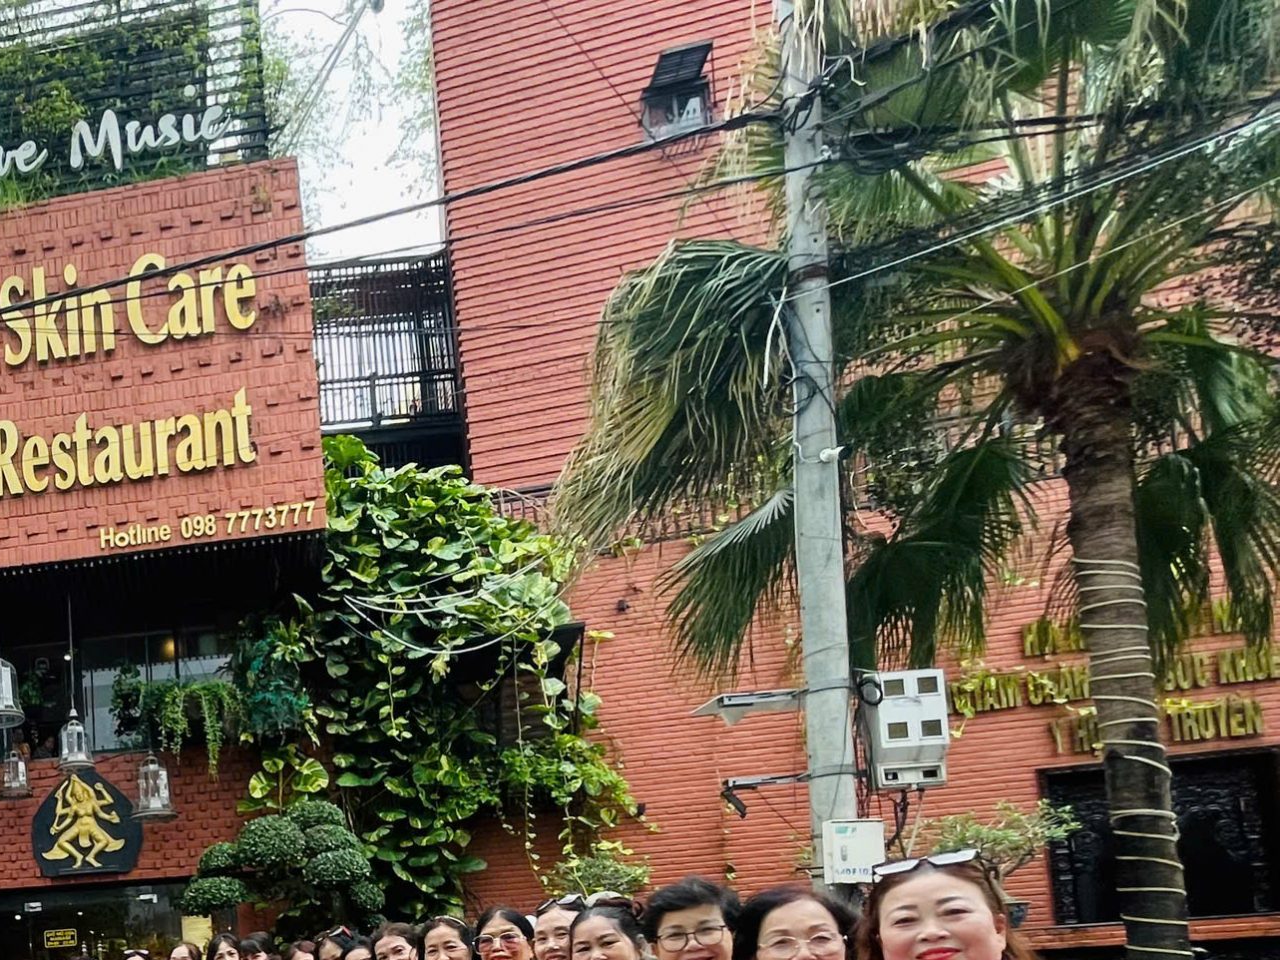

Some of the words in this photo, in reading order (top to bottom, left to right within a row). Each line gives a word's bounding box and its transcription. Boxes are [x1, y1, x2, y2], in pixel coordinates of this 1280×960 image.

[70, 84, 232, 171] Music
[0, 263, 116, 366] Skin
[126, 252, 257, 345] Care
[100, 524, 171, 549] Hotline
[180, 514, 217, 539] 098
[225, 501, 316, 535] 7773777
